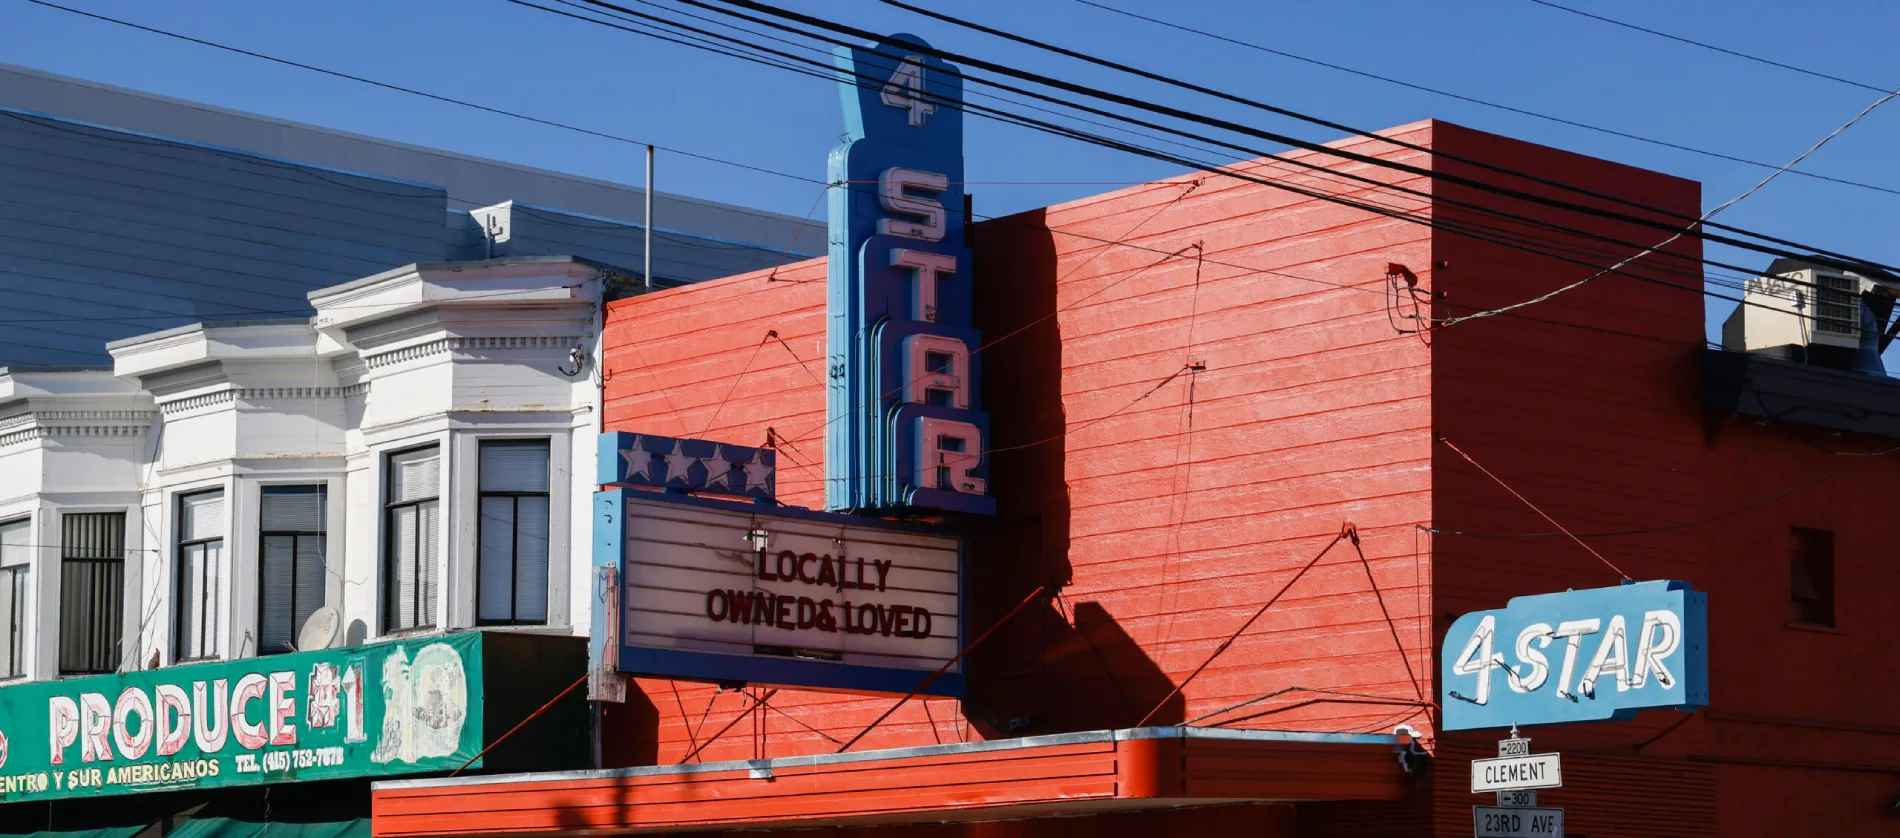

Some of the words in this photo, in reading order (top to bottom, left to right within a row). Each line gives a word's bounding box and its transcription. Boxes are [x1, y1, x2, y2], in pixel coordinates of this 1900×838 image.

[880, 54, 937, 127] 4
[877, 166, 988, 496] STAR
[758, 547, 892, 592] LOCALLY
[845, 601, 932, 639] LOVED
[1453, 615, 1504, 705] 4
[1507, 610, 1681, 697] STAR
[49, 671, 296, 765] PRODUCE
[308, 662, 366, 743] #1
[235, 754, 260, 773] TEL.
[263, 751, 290, 774] (415)
[1507, 742, 1527, 755] 2200
[52, 770, 64, 790] Y
[68, 767, 102, 790] SUR
[106, 759, 219, 785] AMERICANOS
[1485, 762, 1546, 784] CLEMENT
[1511, 793, 1530, 805] 300
[1485, 813, 1521, 833] 23RD
[1530, 815, 1554, 833] AVE
